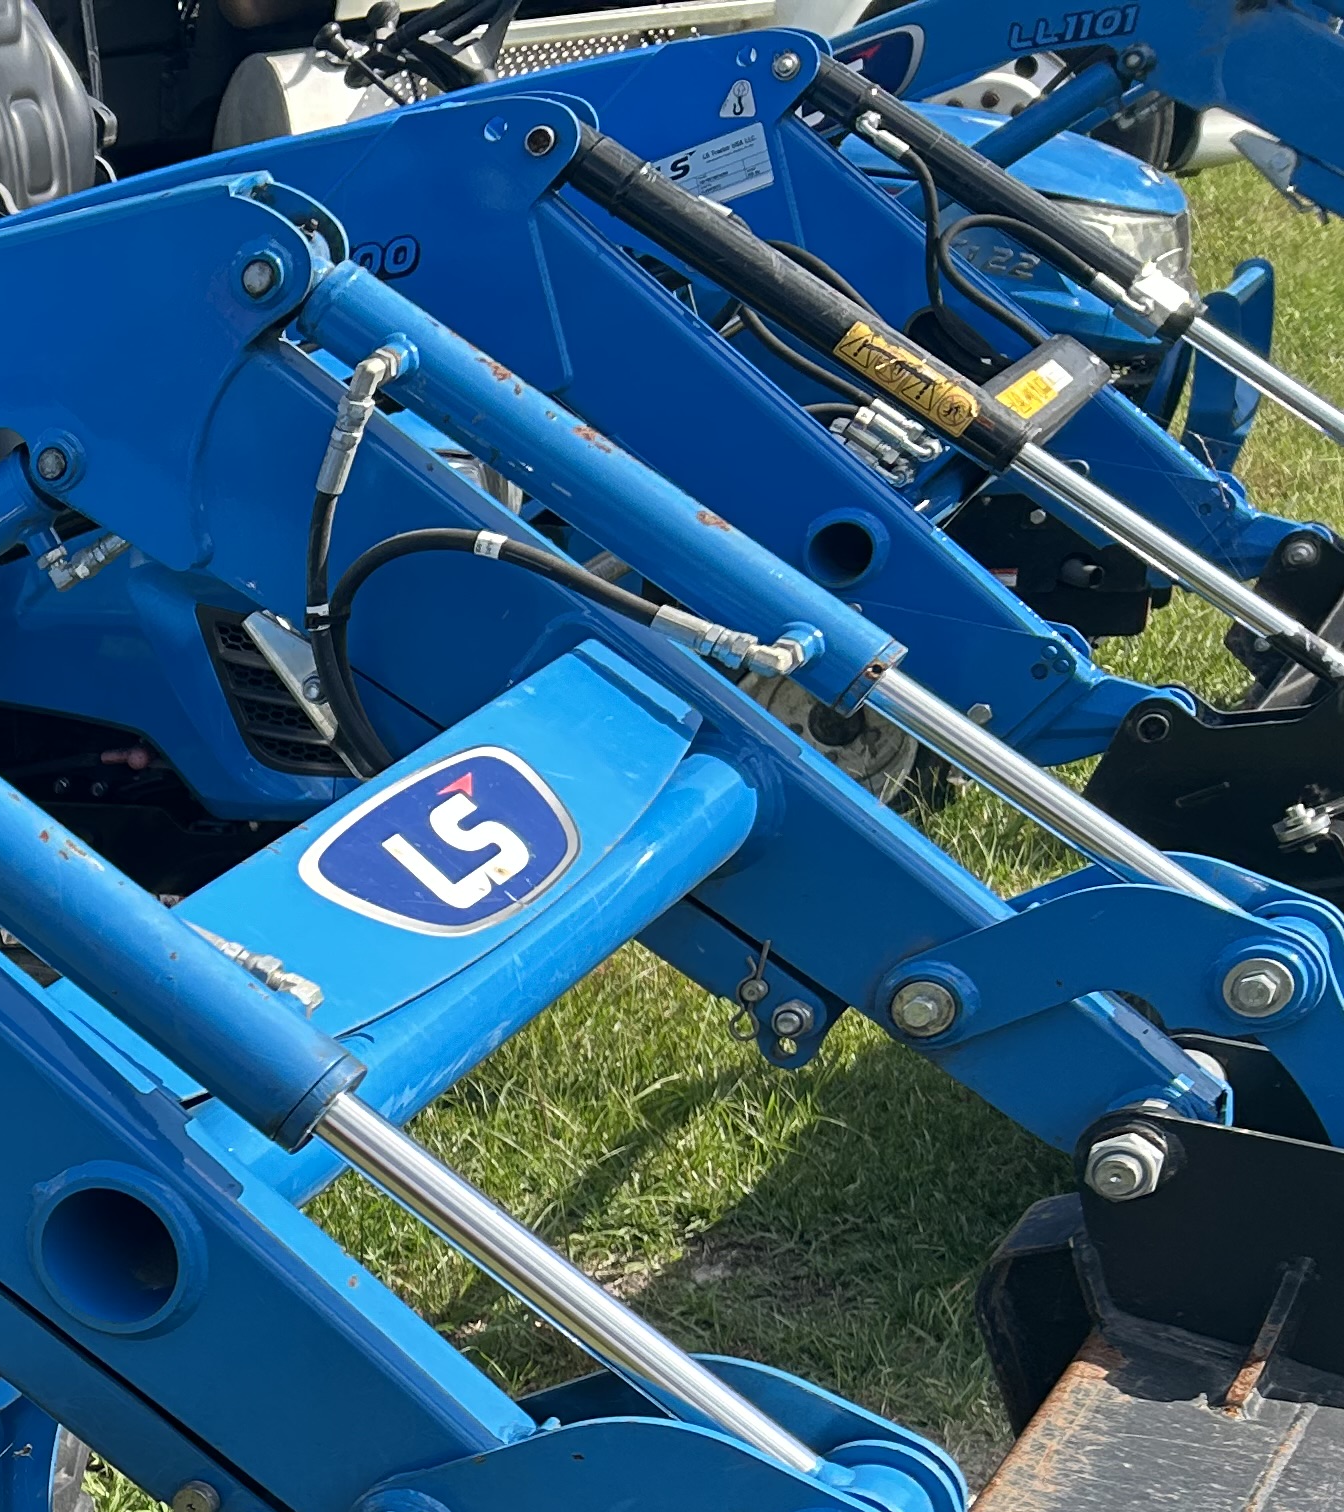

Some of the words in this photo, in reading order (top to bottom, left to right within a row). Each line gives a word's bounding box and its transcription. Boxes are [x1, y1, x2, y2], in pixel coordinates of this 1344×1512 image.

[1009, 4, 1139, 50] LL1101
[350, 233, 421, 281] 00
[381, 791, 530, 909] LS
